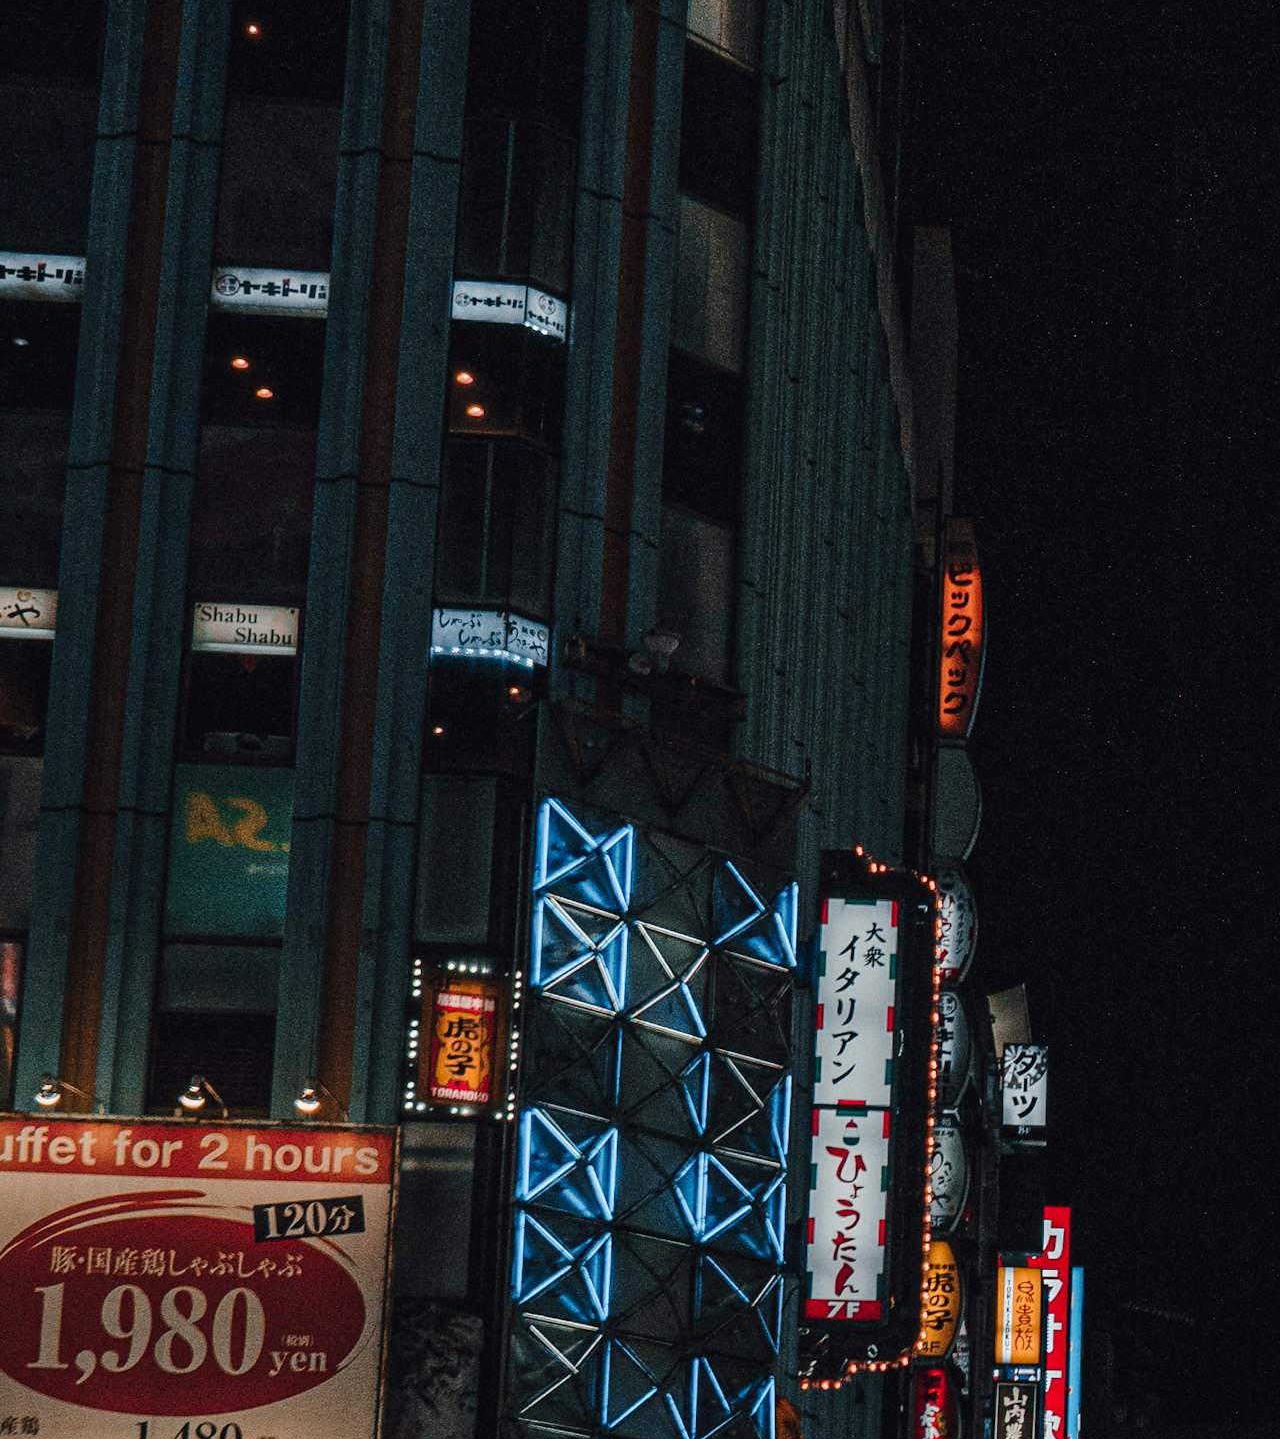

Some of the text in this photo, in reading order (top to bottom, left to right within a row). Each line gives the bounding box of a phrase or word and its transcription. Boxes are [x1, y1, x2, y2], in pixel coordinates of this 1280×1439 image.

[200, 606, 258, 624] Shabu
[234, 627, 292, 645] Shabu
[863, 923, 887, 969] 大衆
[831, 935, 861, 1085] イタリアン
[443, 1017, 480, 1076] 虎の子
[113, 1130, 380, 1176] for 2 hours
[263, 1200, 357, 1239] 120分
[826, 1146, 868, 1297] ひょうたん
[826, 1301, 861, 1319] 7F
[27, 1282, 267, 1385] 1,980
[268, 1348, 327, 1377] yen
